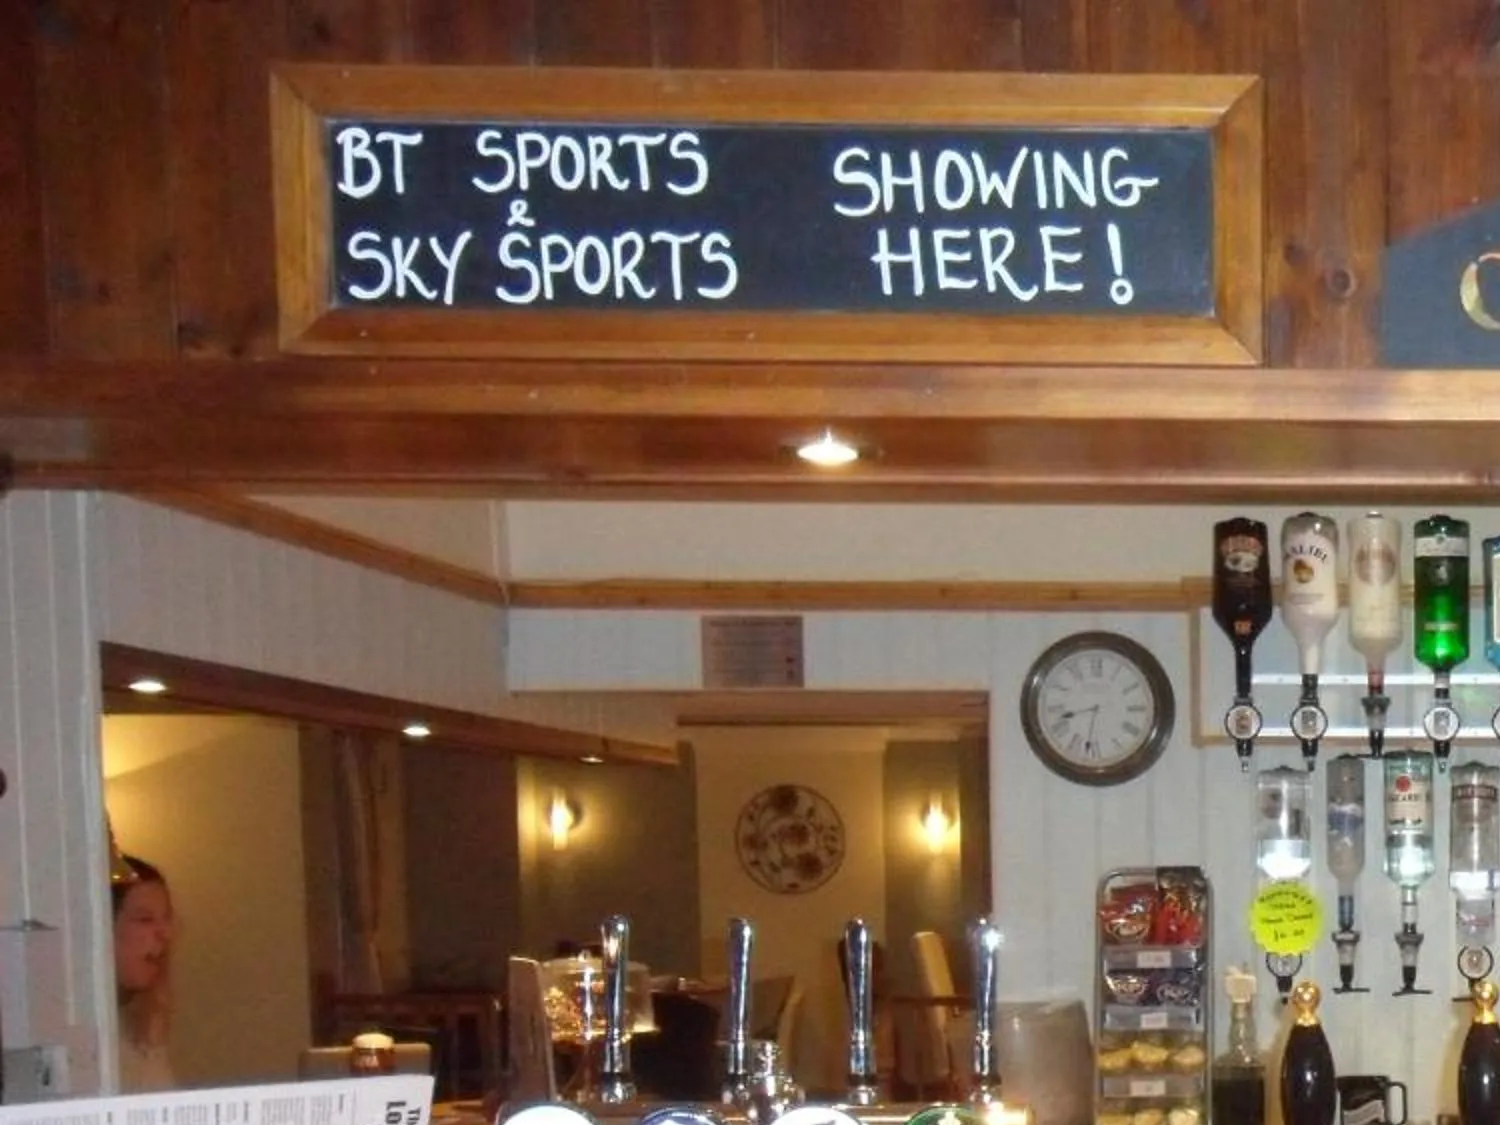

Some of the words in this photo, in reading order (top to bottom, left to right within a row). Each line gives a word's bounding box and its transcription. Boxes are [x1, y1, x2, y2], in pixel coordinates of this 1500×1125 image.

[337, 127, 423, 198] BT
[472, 131, 709, 196] SPORTS
[832, 145, 1160, 217] SHOWING
[506, 199, 536, 228] &
[346, 231, 474, 306] SKY
[495, 231, 740, 304] SPORTS
